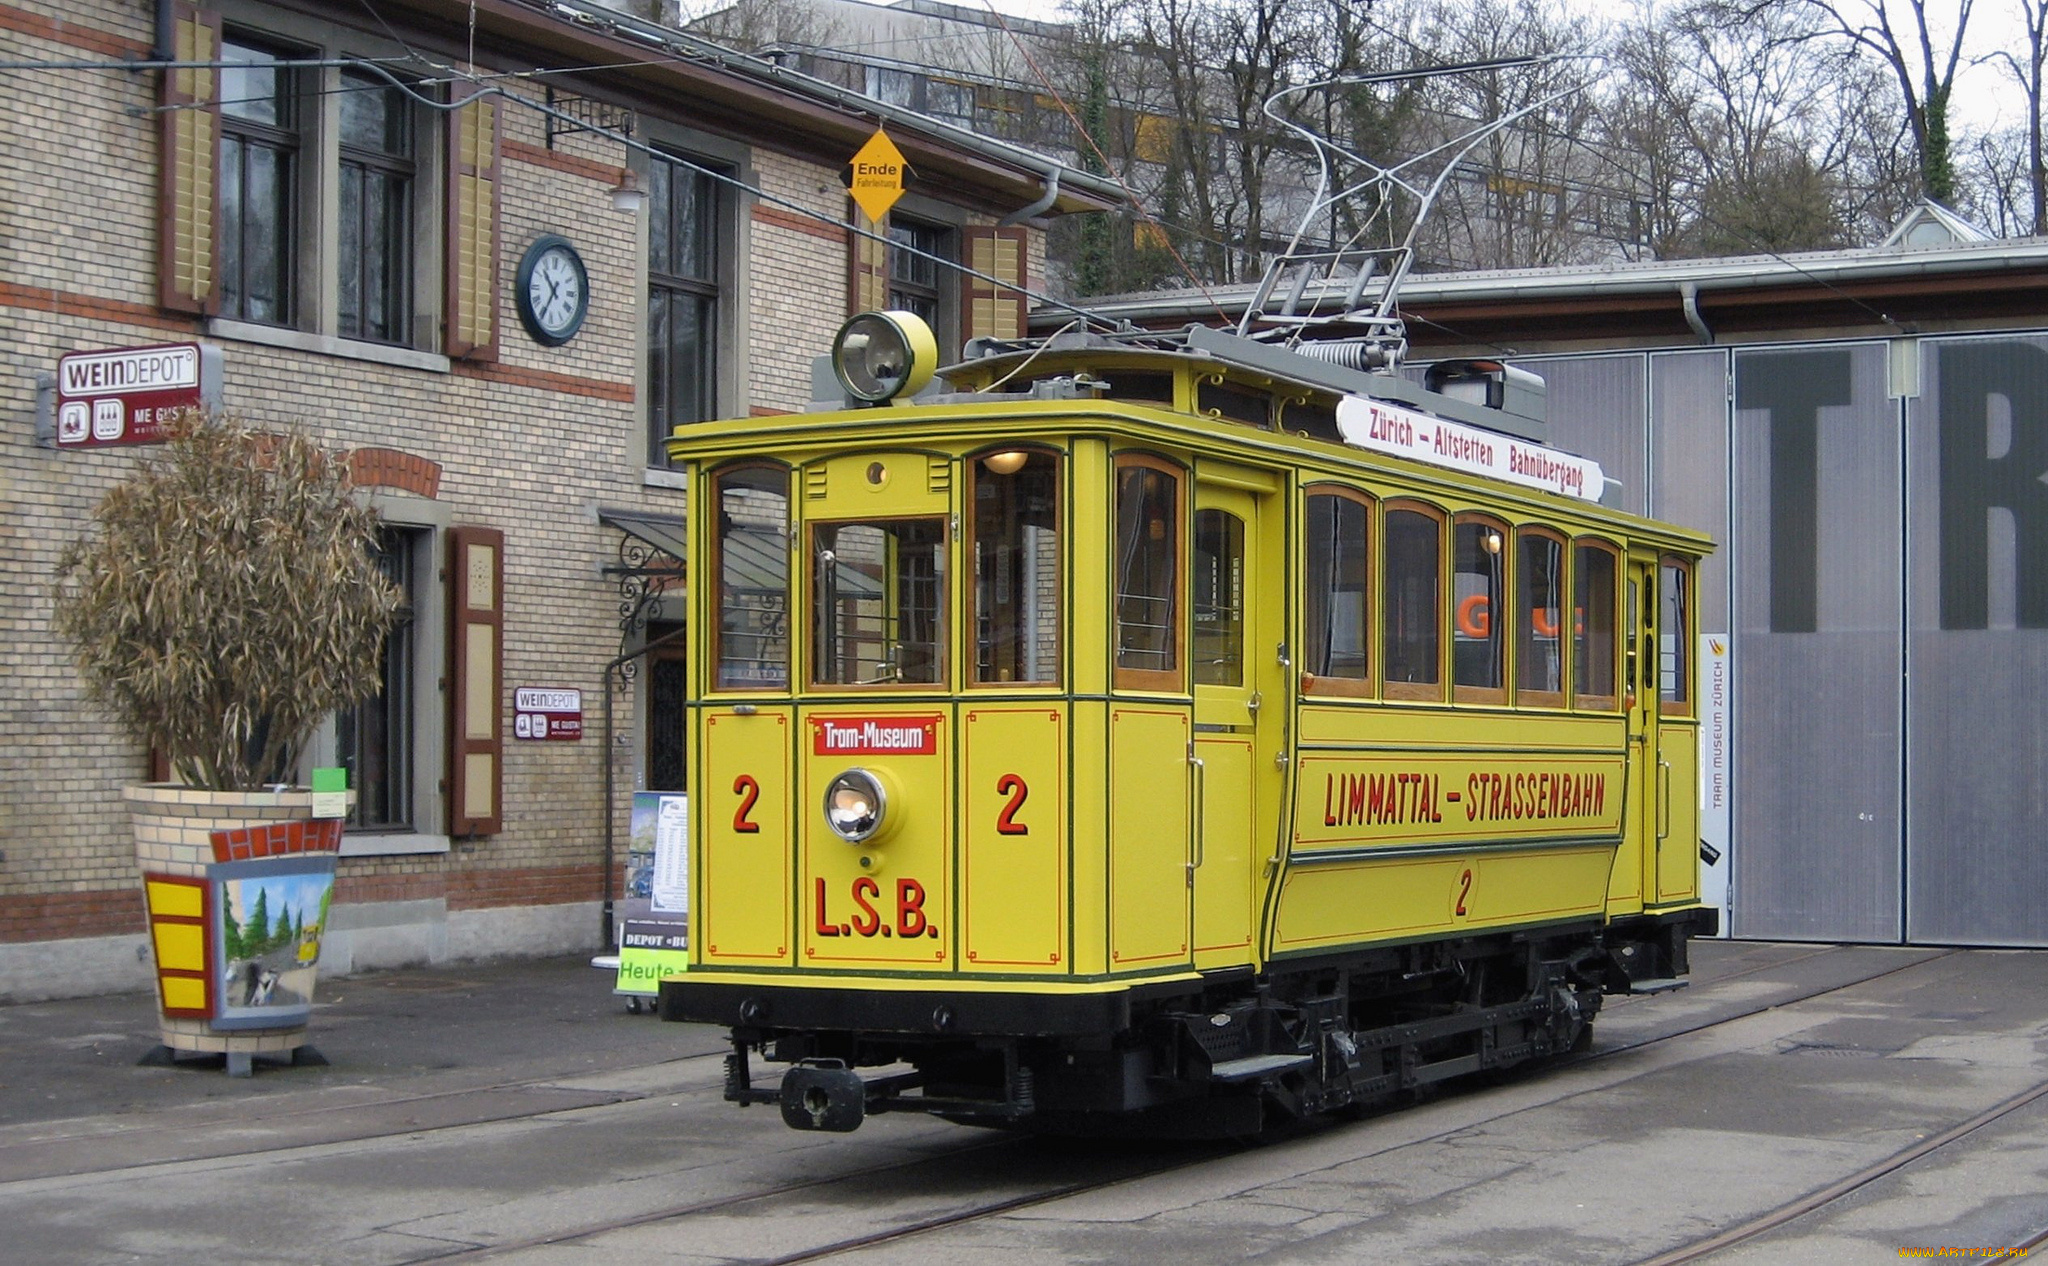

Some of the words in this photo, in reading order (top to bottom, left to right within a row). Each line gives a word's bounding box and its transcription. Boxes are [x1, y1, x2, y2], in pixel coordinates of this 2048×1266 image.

[858, 162, 897, 175] Ende
[134, 408, 152, 423] ME
[1369, 408, 1413, 447] Zürich
[1434, 425, 1494, 467] Altstetten
[1509, 444, 1584, 497] Bahnübergang
[1711, 661, 1723, 707] ZÜRICH
[824, 722, 923, 749] Tram-Museum
[1713, 711, 1723, 769] MUSEUM
[732, 774, 760, 833] 2
[996, 773, 1029, 835] 2
[1713, 772, 1723, 810] TRAM
[815, 876, 939, 937] L.S.B.
[1455, 869, 1472, 917] 2
[626, 934, 664, 946] DEPOT
[620, 961, 675, 979] Heute
